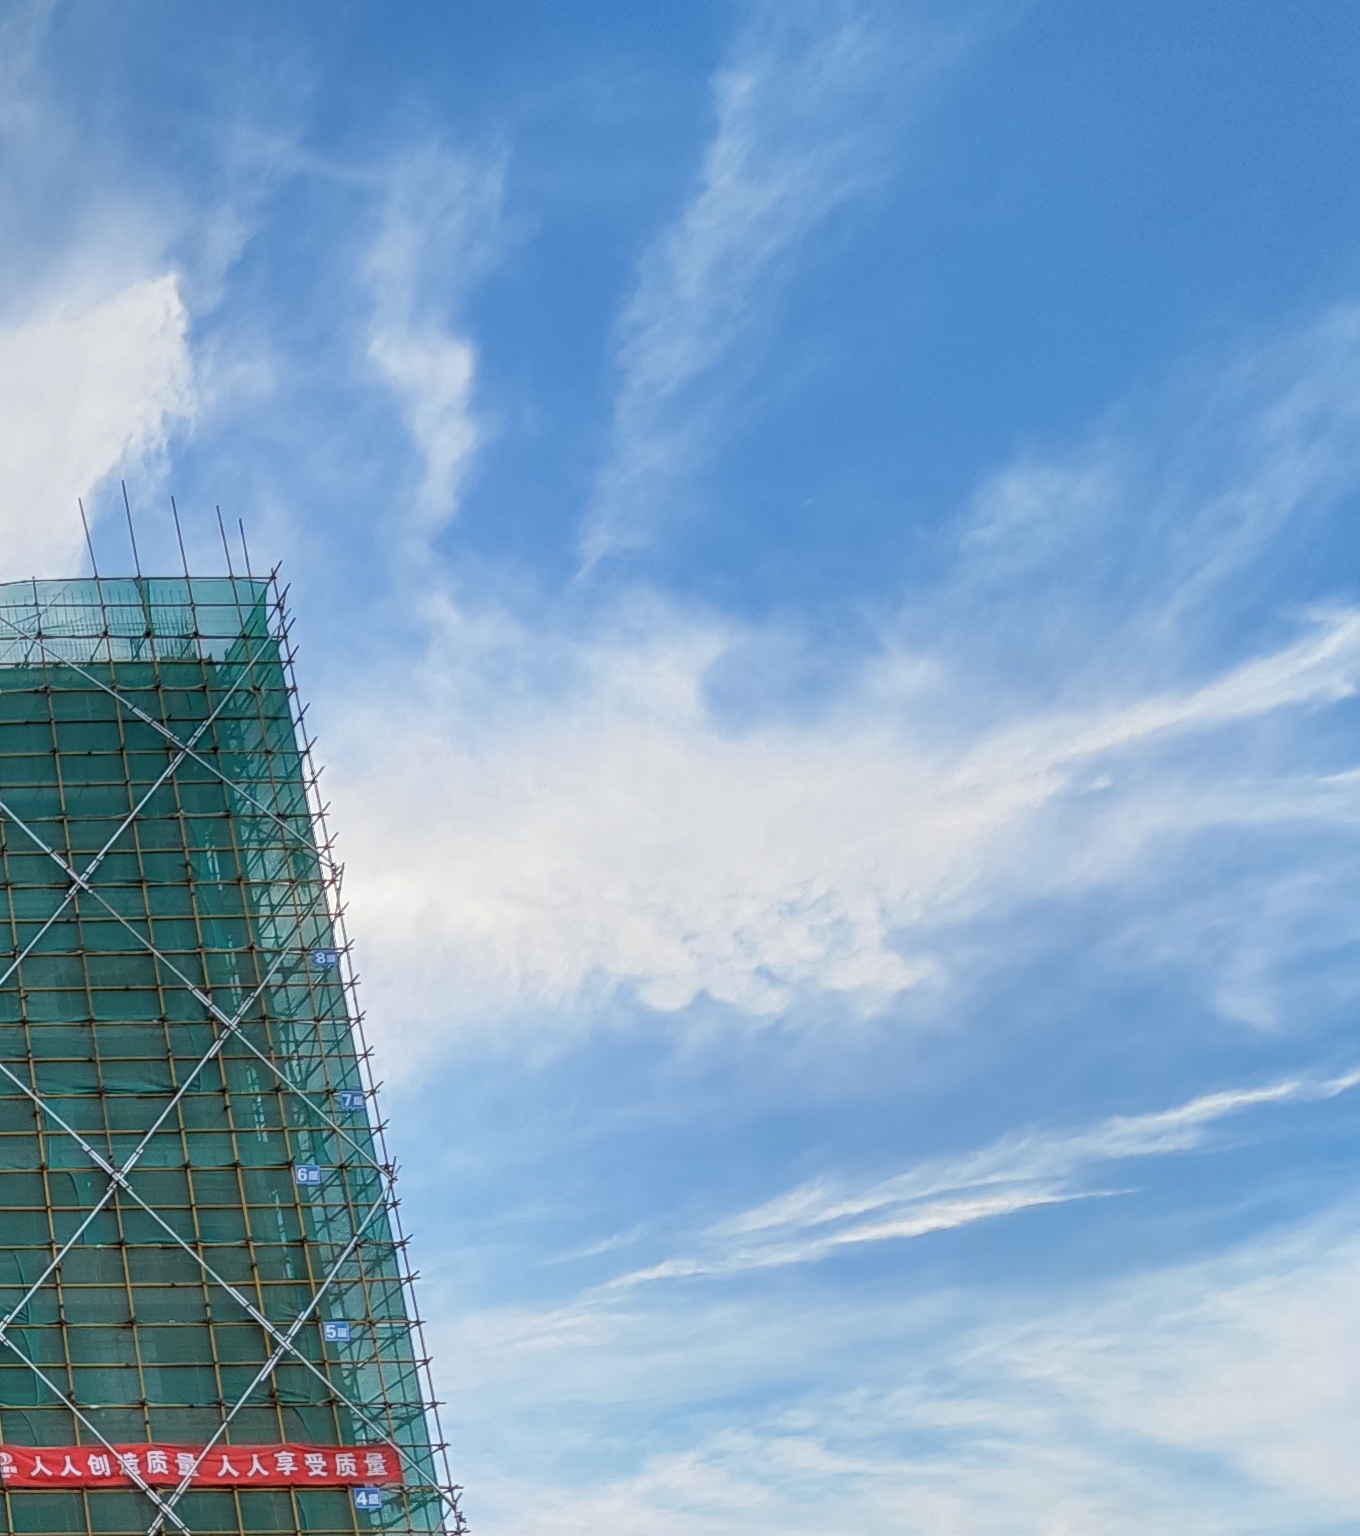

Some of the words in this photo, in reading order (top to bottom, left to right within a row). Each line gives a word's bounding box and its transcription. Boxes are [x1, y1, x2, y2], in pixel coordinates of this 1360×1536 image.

[30, 1450, 199, 1477] 人人创造质量
[217, 1450, 388, 1477] 人人享受质量
